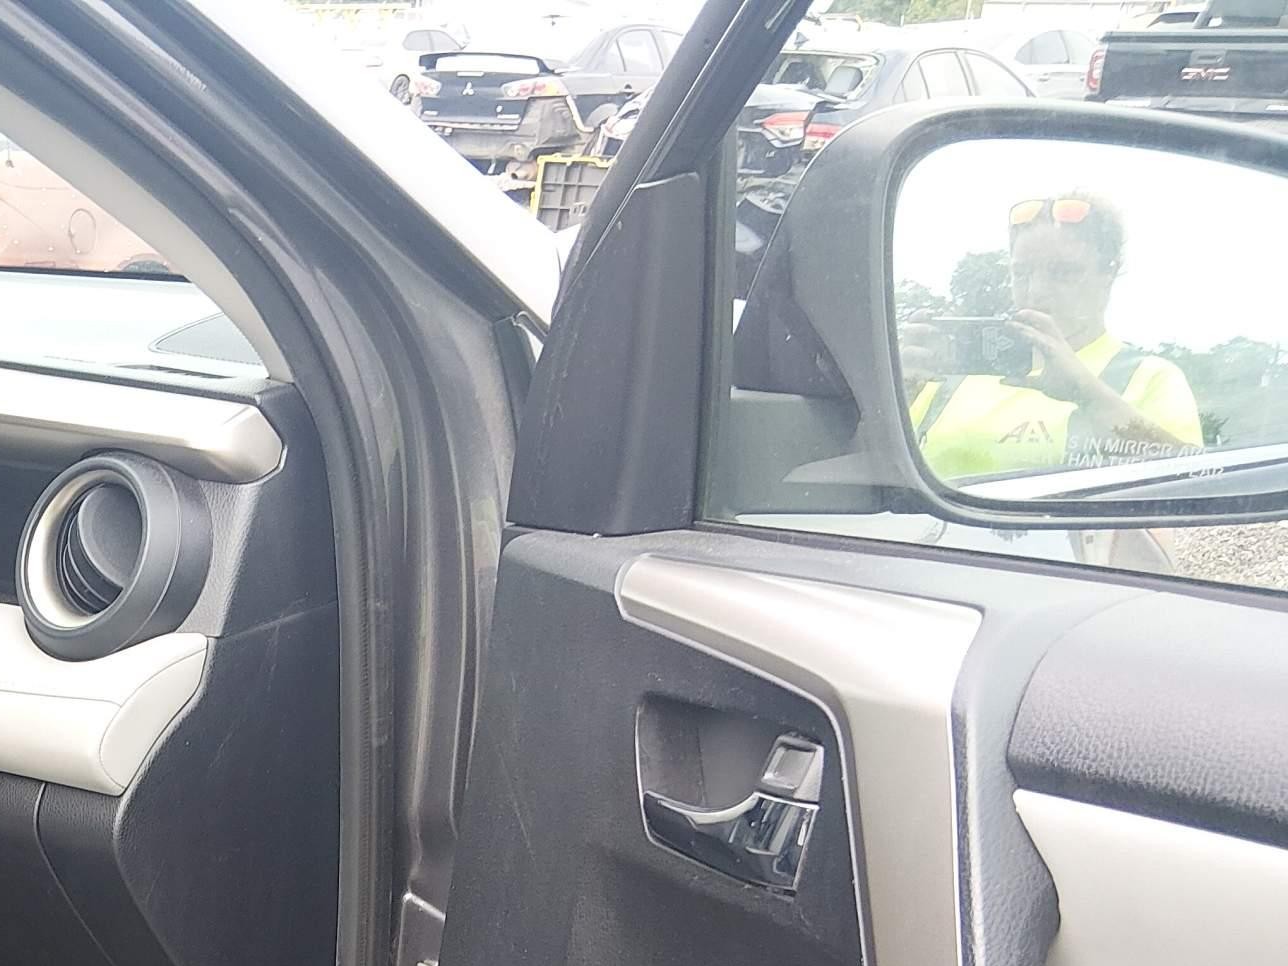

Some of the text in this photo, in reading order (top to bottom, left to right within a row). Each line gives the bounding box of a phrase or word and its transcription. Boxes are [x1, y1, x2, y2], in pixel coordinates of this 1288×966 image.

[1181, 67, 1231, 81] GMC
[1083, 436, 1102, 451] IN
[1104, 437, 1173, 457] MIRROR
